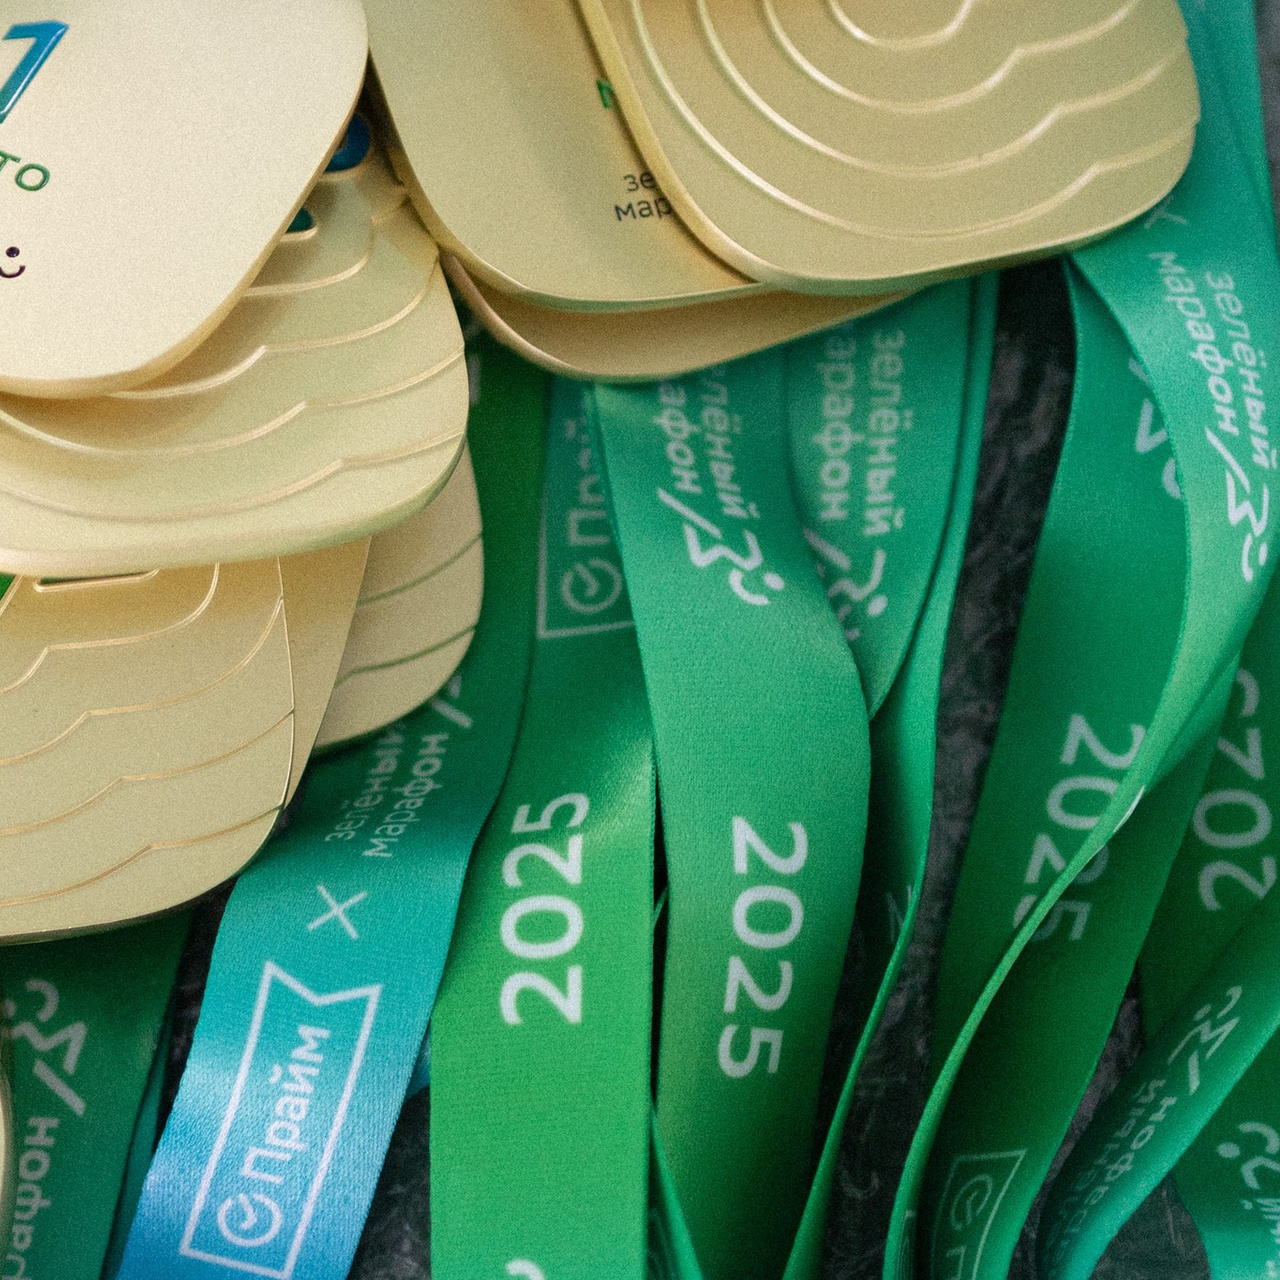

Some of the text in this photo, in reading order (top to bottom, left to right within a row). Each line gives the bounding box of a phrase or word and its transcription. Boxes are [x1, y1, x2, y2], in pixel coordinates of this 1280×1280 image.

[811, 330, 866, 521] арафон
[862, 327, 915, 536] зелёный
[1148, 251, 1241, 437] марафон
[1203, 268, 1279, 471] зелёный
[362, 731, 451, 860] марафон
[498, 791, 589, 1026] 2025
[716, 815, 809, 1079] 2025
[238, 1024, 332, 1185] Прайм
